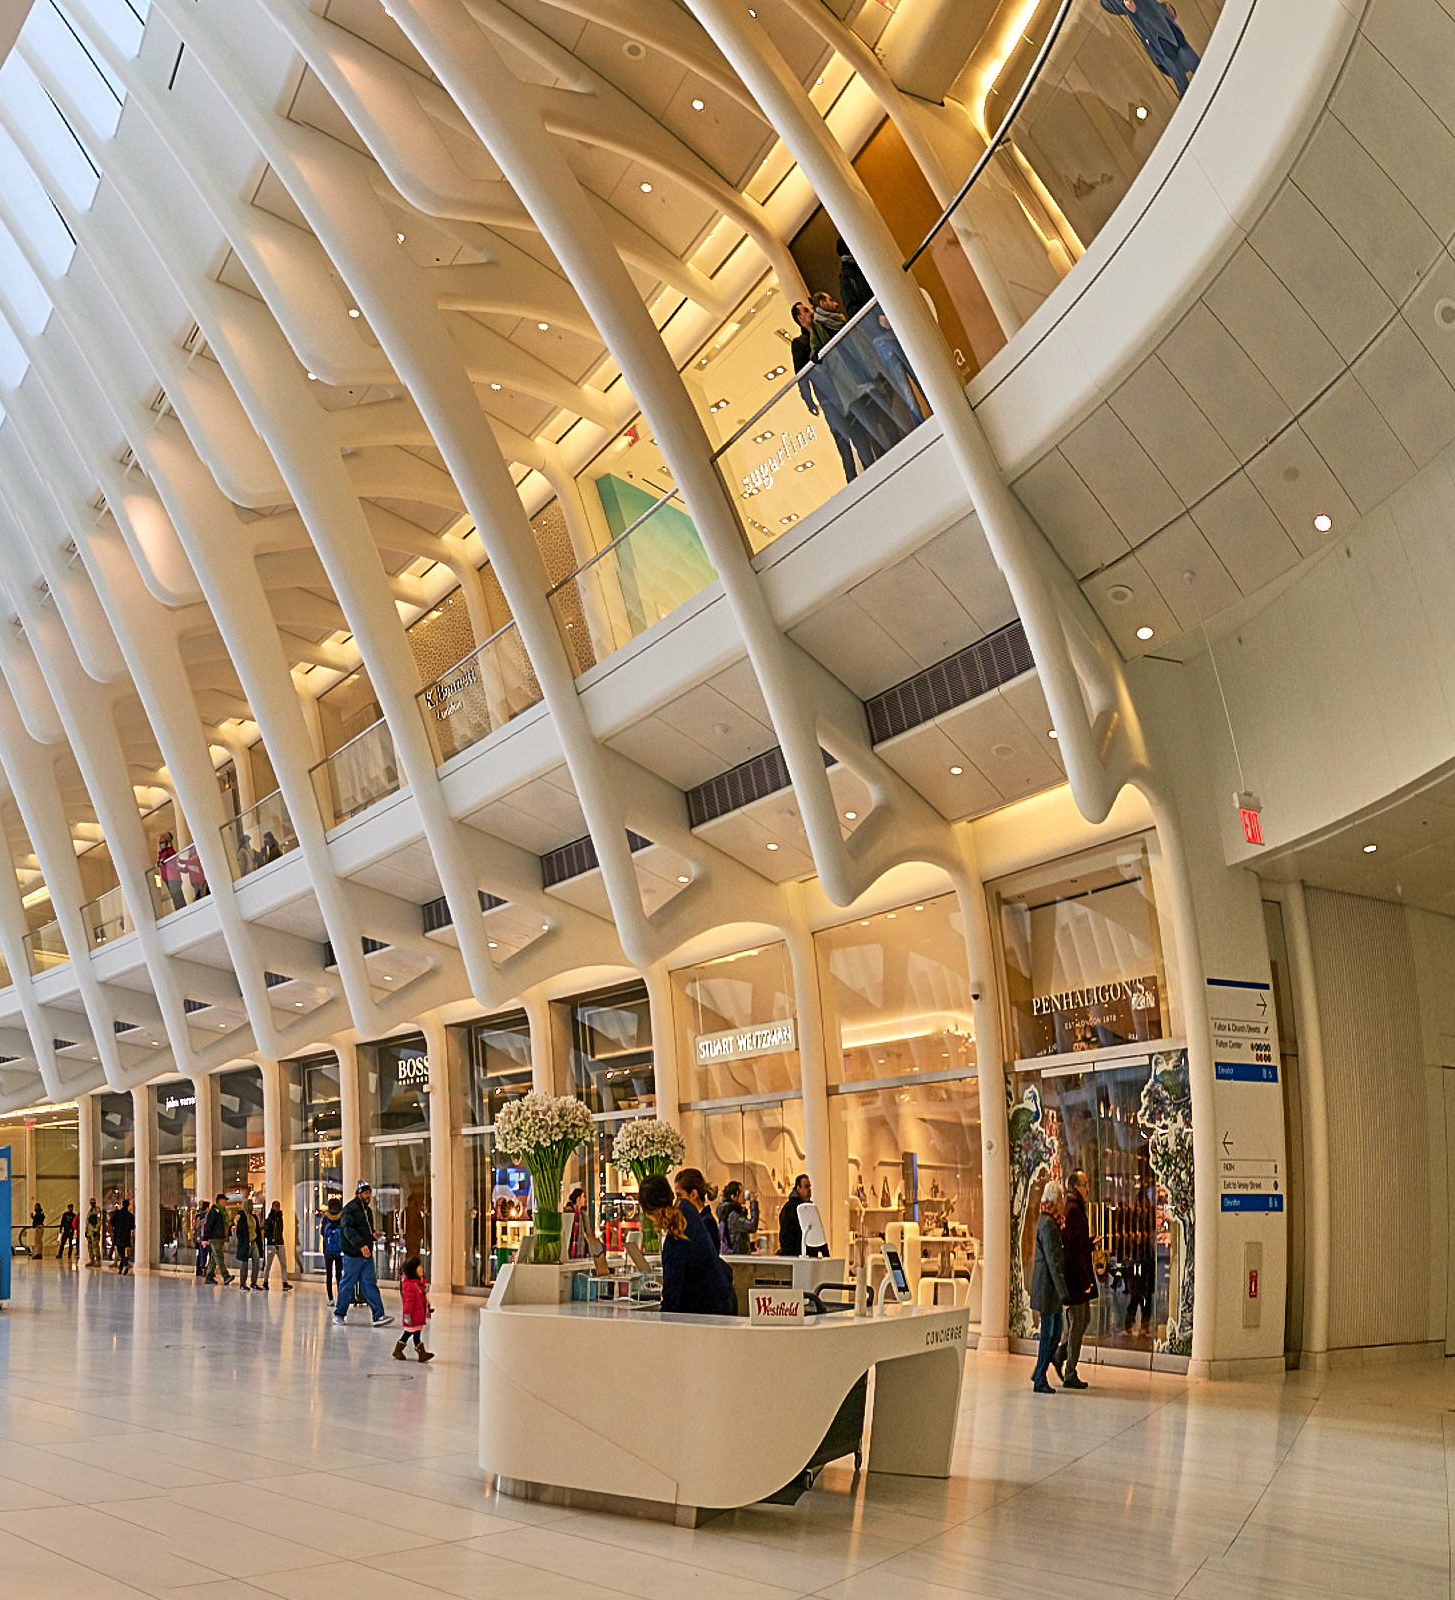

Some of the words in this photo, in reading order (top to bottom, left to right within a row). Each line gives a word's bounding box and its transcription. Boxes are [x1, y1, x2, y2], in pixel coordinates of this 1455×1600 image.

[742, 425, 817, 494] sugarfina
[1240, 809, 1263, 844] EXIT
[1032, 977, 1145, 1016] PENHALIGON'S
[698, 1036, 734, 1059] STUART
[737, 1025, 792, 1052] WEITZMAN
[398, 1055, 430, 1079] BOSS
[755, 1296, 800, 1317] Westfield
[925, 1325, 963, 1346] CONCIERGE
